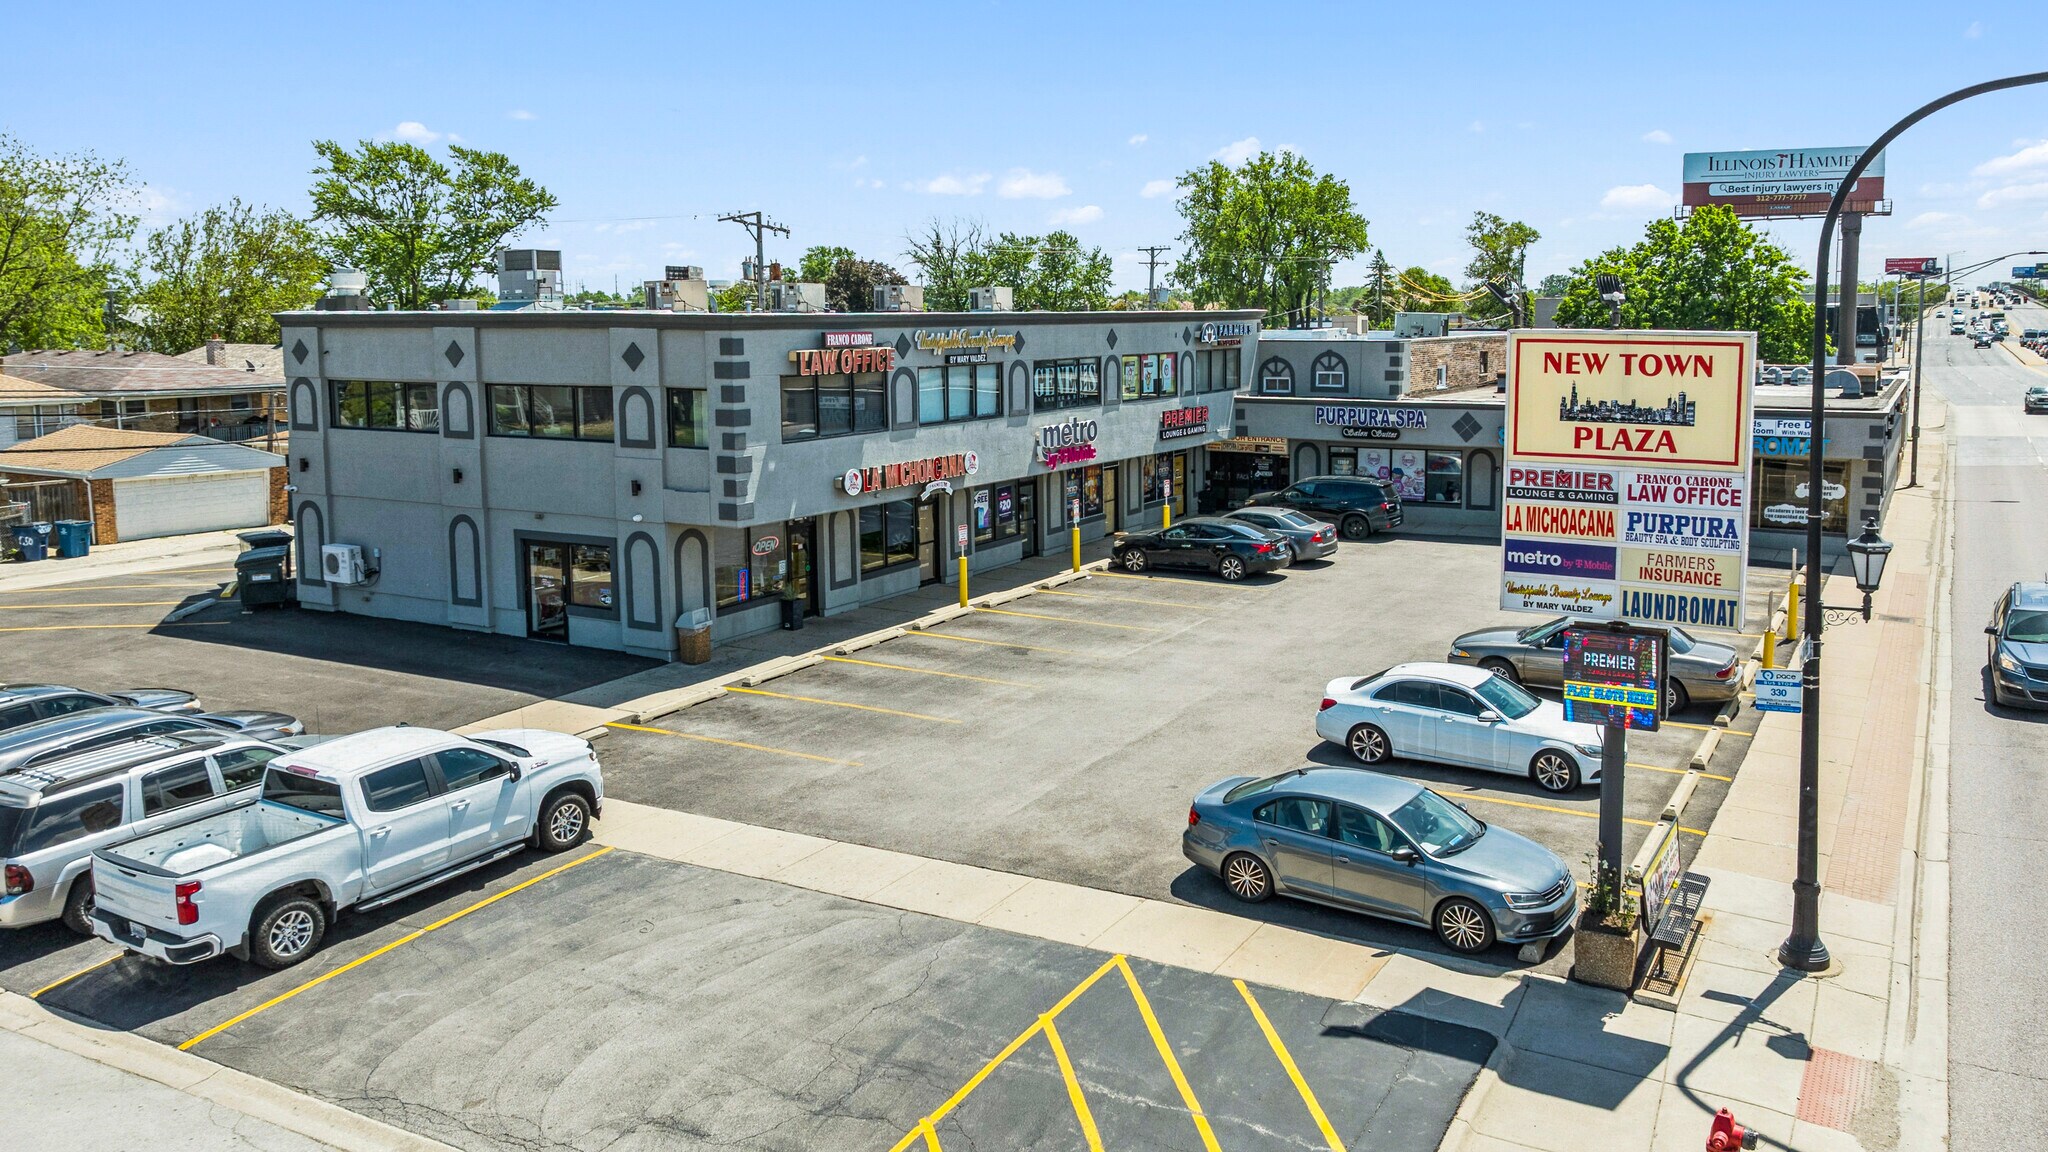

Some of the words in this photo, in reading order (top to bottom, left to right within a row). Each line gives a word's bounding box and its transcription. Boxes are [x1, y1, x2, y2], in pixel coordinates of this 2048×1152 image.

[1744, 171, 1776, 179] INJURY
[1778, 169, 1820, 178] LAWYERS
[1728, 185, 1750, 193] Best
[1752, 183, 1781, 194] injury
[1783, 182, 1822, 193] lawyers
[1824, 181, 1834, 190] in
[1755, 194, 1808, 202] 312-777-7777
[827, 334, 850, 346] FRANCO
[850, 333, 873, 345] CARONE
[1218, 323, 1254, 337] FARMERS
[800, 349, 838, 376] LAW
[841, 348, 896, 374] OFFICE
[949, 356, 957, 364] BY
[957, 355, 970, 363] MARY
[970, 354, 987, 363] VALDEZ
[1543, 352, 1610, 375] NEW
[1619, 353, 1714, 378] TOWN
[1163, 406, 1209, 428] PREMIER
[1315, 406, 1393, 427] PURPURA
[1395, 410, 1427, 429] SPA
[1777, 420, 1801, 428] Free
[1043, 417, 1098, 448] metro
[1162, 430, 1183, 440] LOUNGE
[1187, 425, 1206, 436] GAMING
[1342, 428, 1369, 437] Salon
[1371, 429, 1398, 439] Suites
[1573, 426, 1678, 454] PLAZA
[863, 467, 882, 493] LA
[884, 454, 966, 490] MICHOACANA
[1509, 468, 1614, 491] PREMIER
[1636, 473, 1682, 485] FRANCO
[1686, 475, 1733, 488] CARONE
[1509, 488, 1556, 498] LOUNGE
[1558, 491, 1565, 499] &
[1568, 491, 1614, 502] GAMING
[1627, 484, 1668, 503] LAW
[1673, 486, 1742, 507] OFFICE
[1506, 505, 1522, 532] LA
[1526, 506, 1615, 538] MICHOACANA
[1626, 512, 1738, 540] PURPURA
[754, 540, 776, 552] OPEN
[1625, 532, 1654, 544] BEAUTY
[1655, 534, 1669, 544] SPA
[1669, 536, 1679, 545] &
[1680, 537, 1699, 547] BODY
[1700, 538, 1740, 550] SCULPTING
[1507, 550, 1562, 567] metro
[1563, 558, 1573, 569] by
[1584, 560, 1613, 571] Mobile
[1647, 553, 1715, 571] FARMERS
[1639, 567, 1722, 586] INSURANCE
[1549, 584, 1581, 603] Beauty
[1581, 587, 1612, 607] Lounge
[1536, 602, 1559, 610] MARY
[1561, 603, 1593, 613] VALDEZ
[1622, 590, 1738, 627] LAUNDROMAT
[1583, 651, 1636, 670] PREMIER
[1566, 683, 1591, 698] PLAY
[1593, 687, 1625, 702] SLOTS
[1626, 690, 1655, 705] HERE
[1770, 688, 1787, 697] 330
